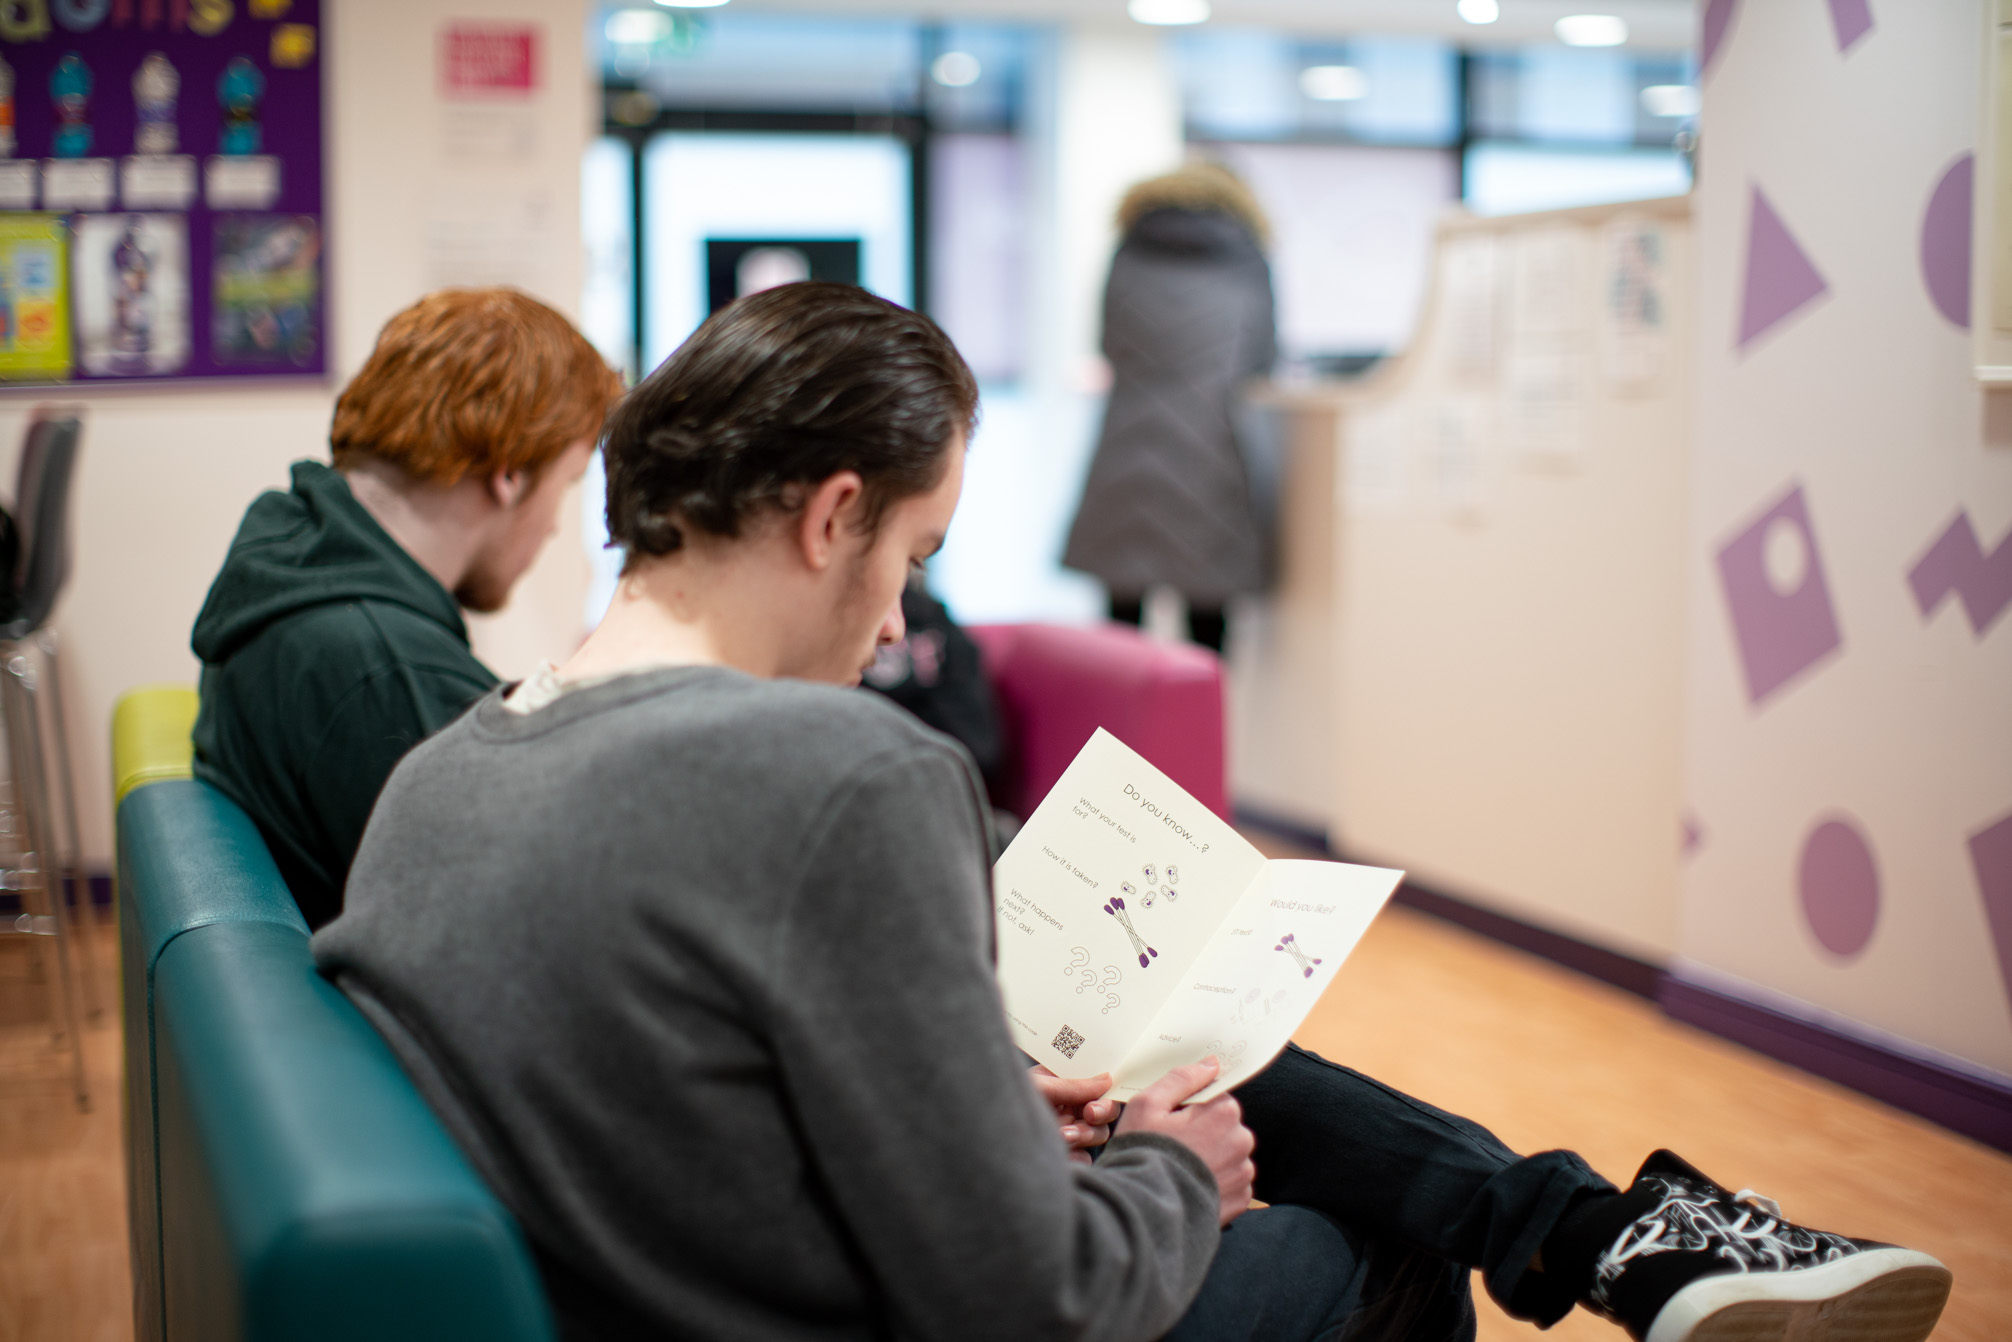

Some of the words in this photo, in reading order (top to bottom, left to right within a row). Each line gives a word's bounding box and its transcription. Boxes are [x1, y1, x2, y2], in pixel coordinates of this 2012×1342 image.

[1072, 805, 1089, 820] for?
[1123, 783, 1141, 801] Do
[1140, 798, 1163, 818] you
[1079, 797, 1100, 815] What
[1098, 811, 1117, 828] your
[1116, 824, 1131, 838] test
[1130, 834, 1137, 843] is
[1042, 845, 1060, 861] How
[1059, 857, 1067, 866] it
[1065, 862, 1072, 871] is
[1071, 867, 1099, 889] taken?
[1003, 898, 1026, 915] next?
[1010, 888, 1032, 906] What
[1030, 903, 1064, 931] happens
[1270, 898, 1296, 910] Would
[1295, 903, 1313, 912] you
[1314, 903, 1337, 915] like?
[1002, 910, 1017, 925] not,
[1018, 922, 1035, 936] ask!
[1193, 983, 1237, 994] Contraception?
